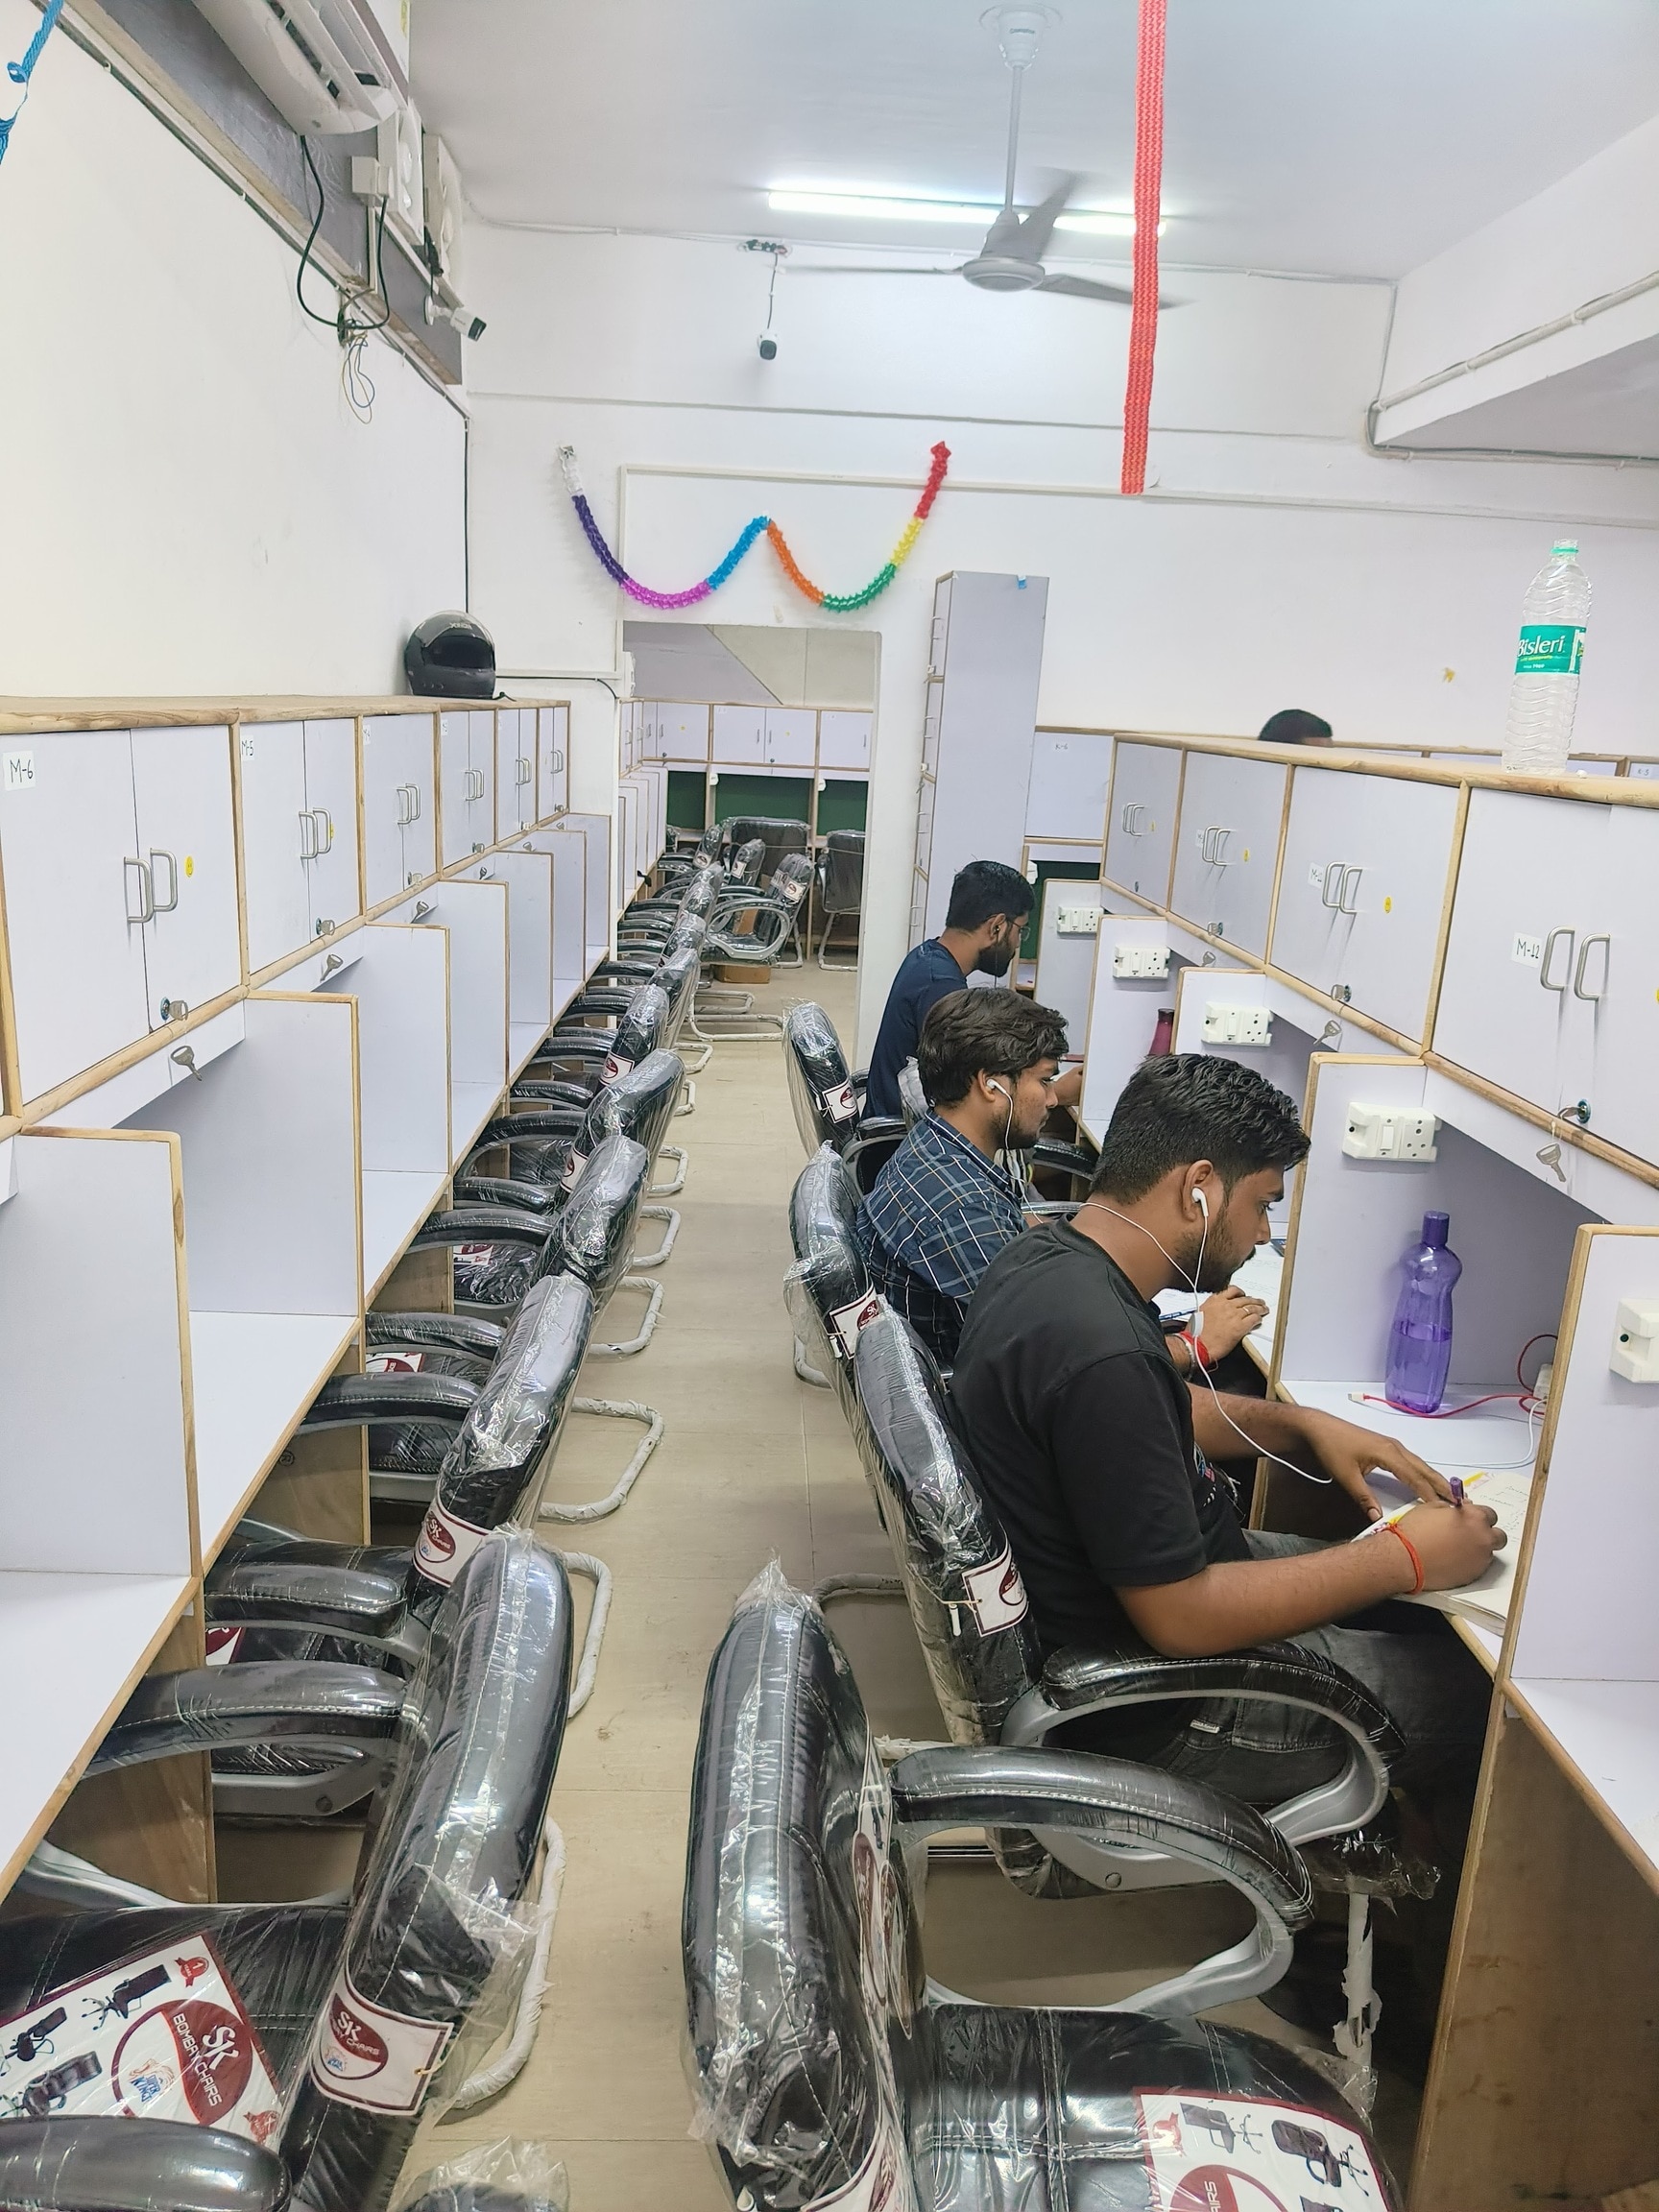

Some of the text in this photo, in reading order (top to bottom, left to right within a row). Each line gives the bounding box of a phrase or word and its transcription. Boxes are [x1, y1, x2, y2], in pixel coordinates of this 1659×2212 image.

[241, 739, 254, 757] M-5
[10, 757, 34, 783] M-6
[1516, 937, 1540, 959] M-12
[337, 2010, 362, 2042] SK
[173, 2012, 223, 2107] BOMBAY CHAIRS
[202, 2025, 240, 2071] SK
[1204, 2180, 1221, 2212] AIRS
